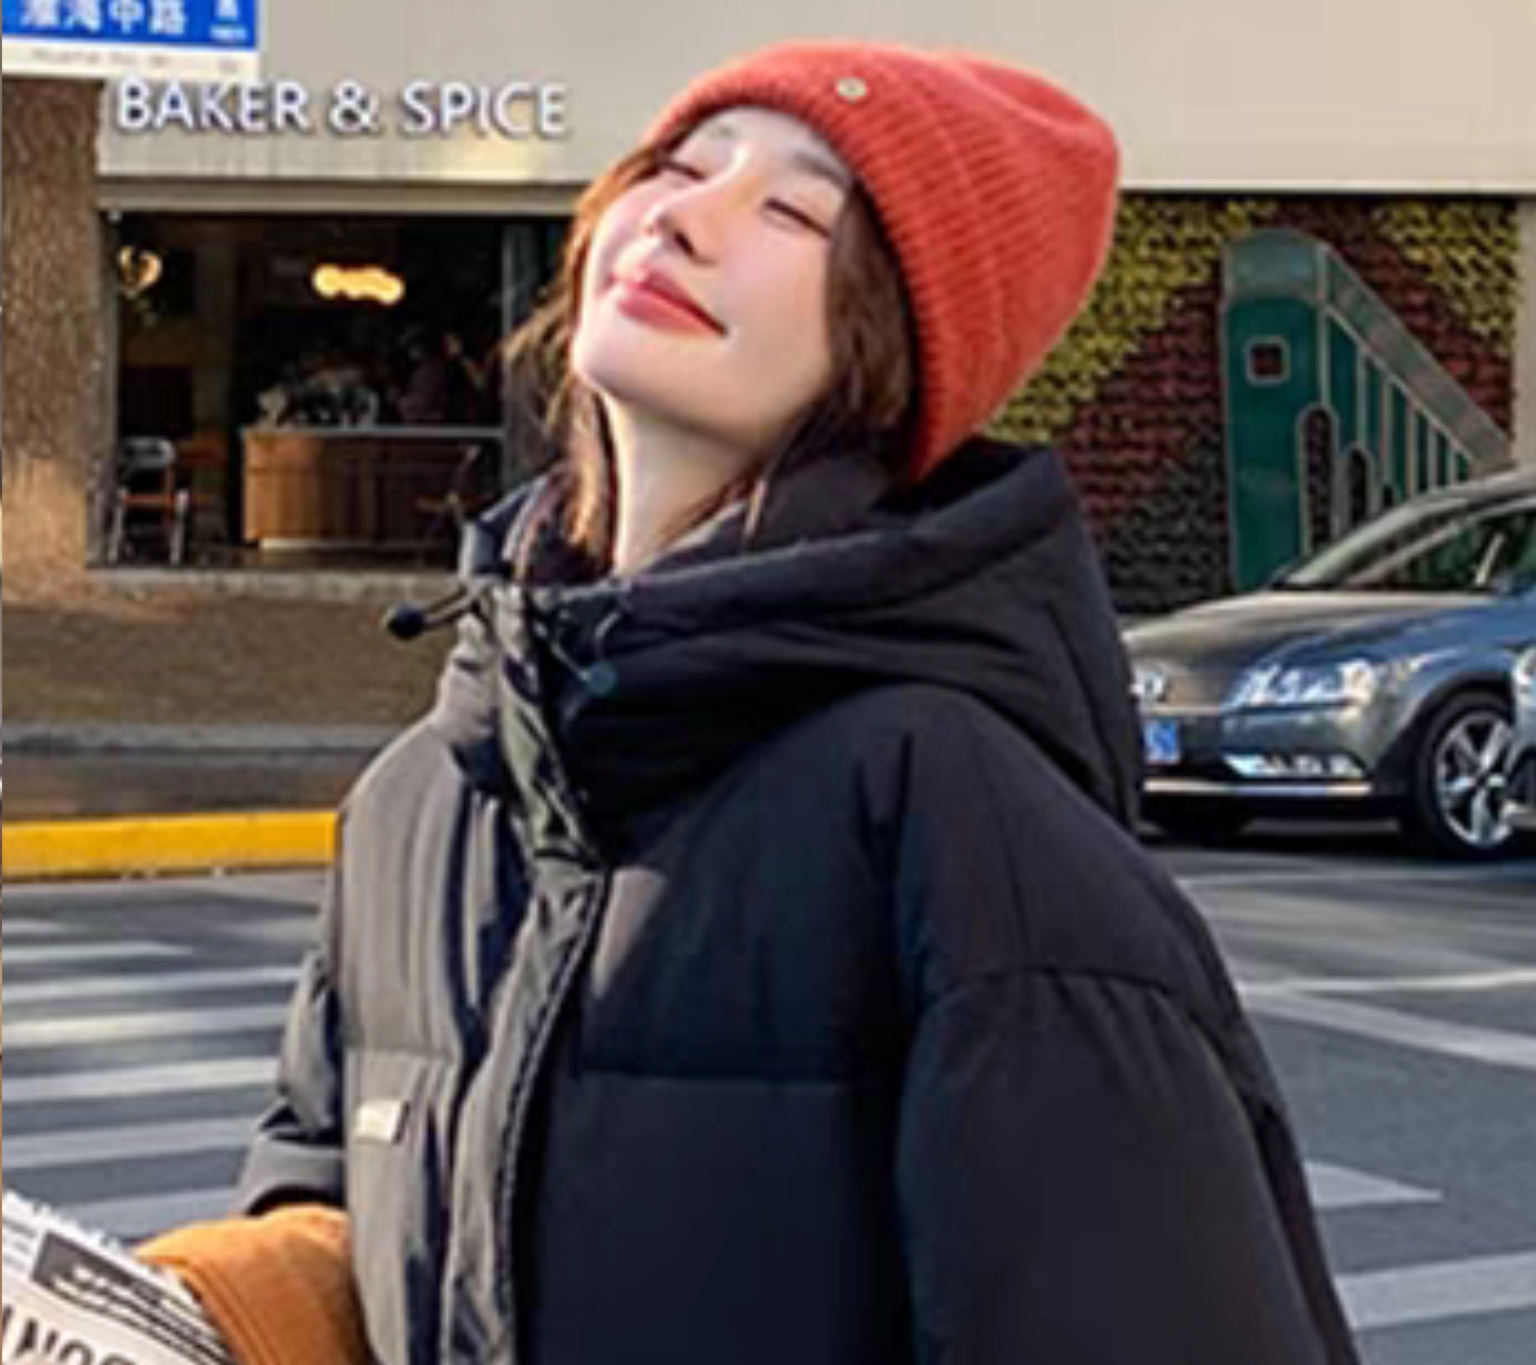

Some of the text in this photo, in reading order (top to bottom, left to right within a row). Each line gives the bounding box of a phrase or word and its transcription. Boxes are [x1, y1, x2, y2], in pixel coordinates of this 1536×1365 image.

[116, 80, 567, 134] BAKER & SPICE
